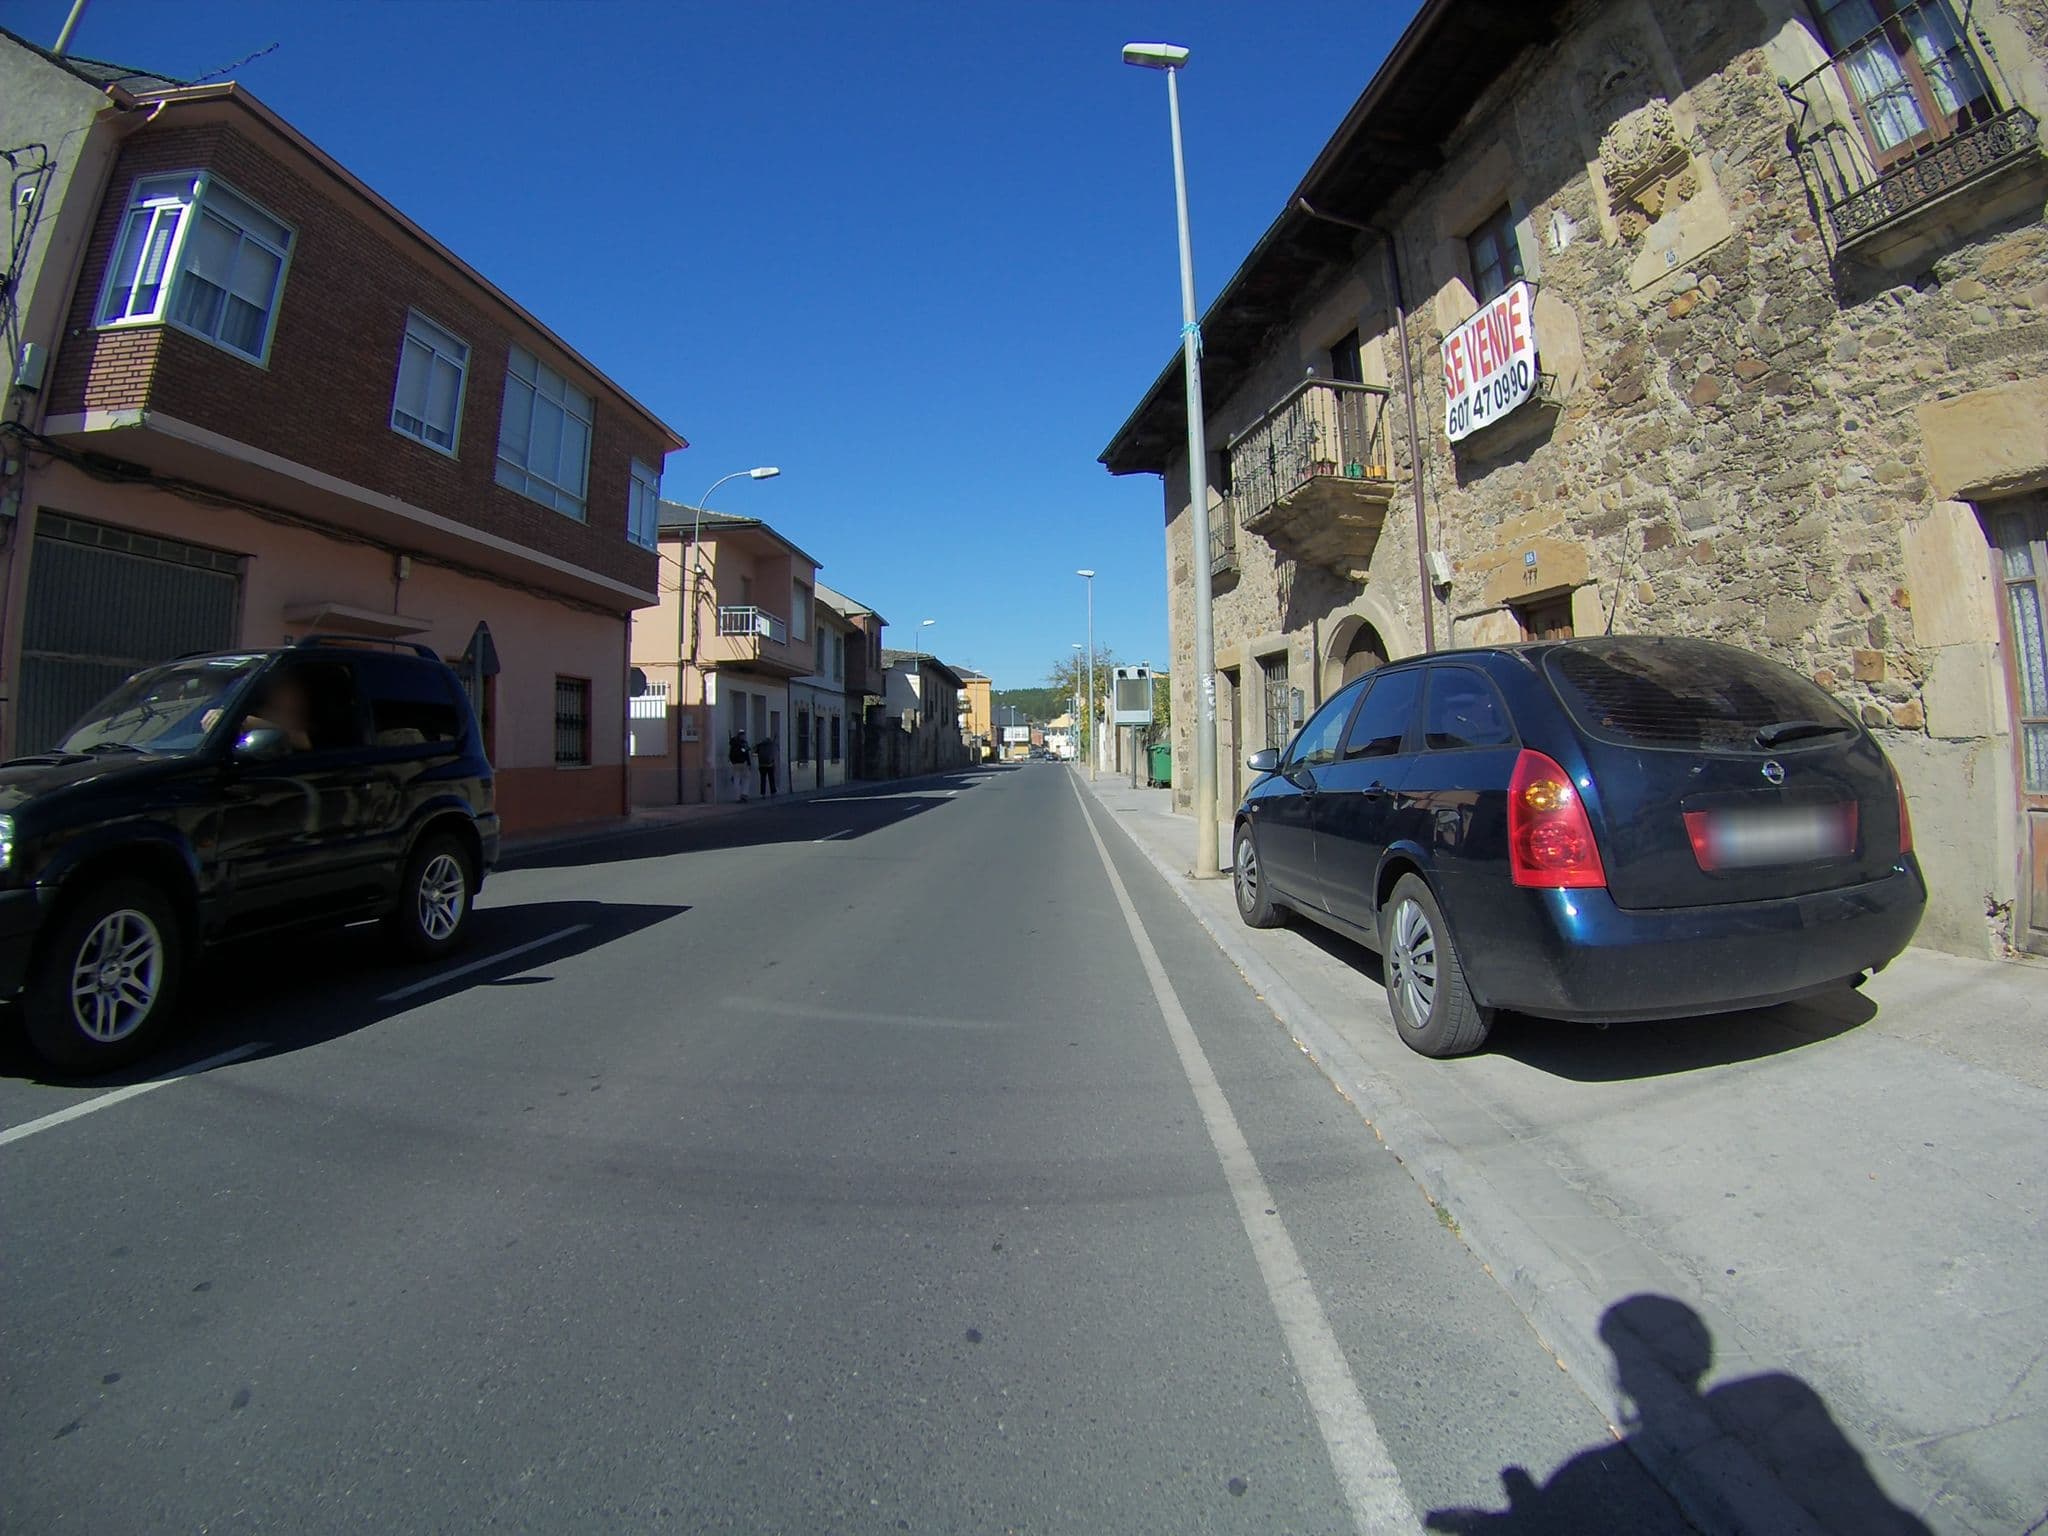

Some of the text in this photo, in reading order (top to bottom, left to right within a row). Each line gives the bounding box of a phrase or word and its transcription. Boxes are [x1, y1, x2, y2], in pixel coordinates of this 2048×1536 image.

[1445, 291, 1525, 400] SE VENDE
[1449, 360, 1528, 435] 607 47 0990
